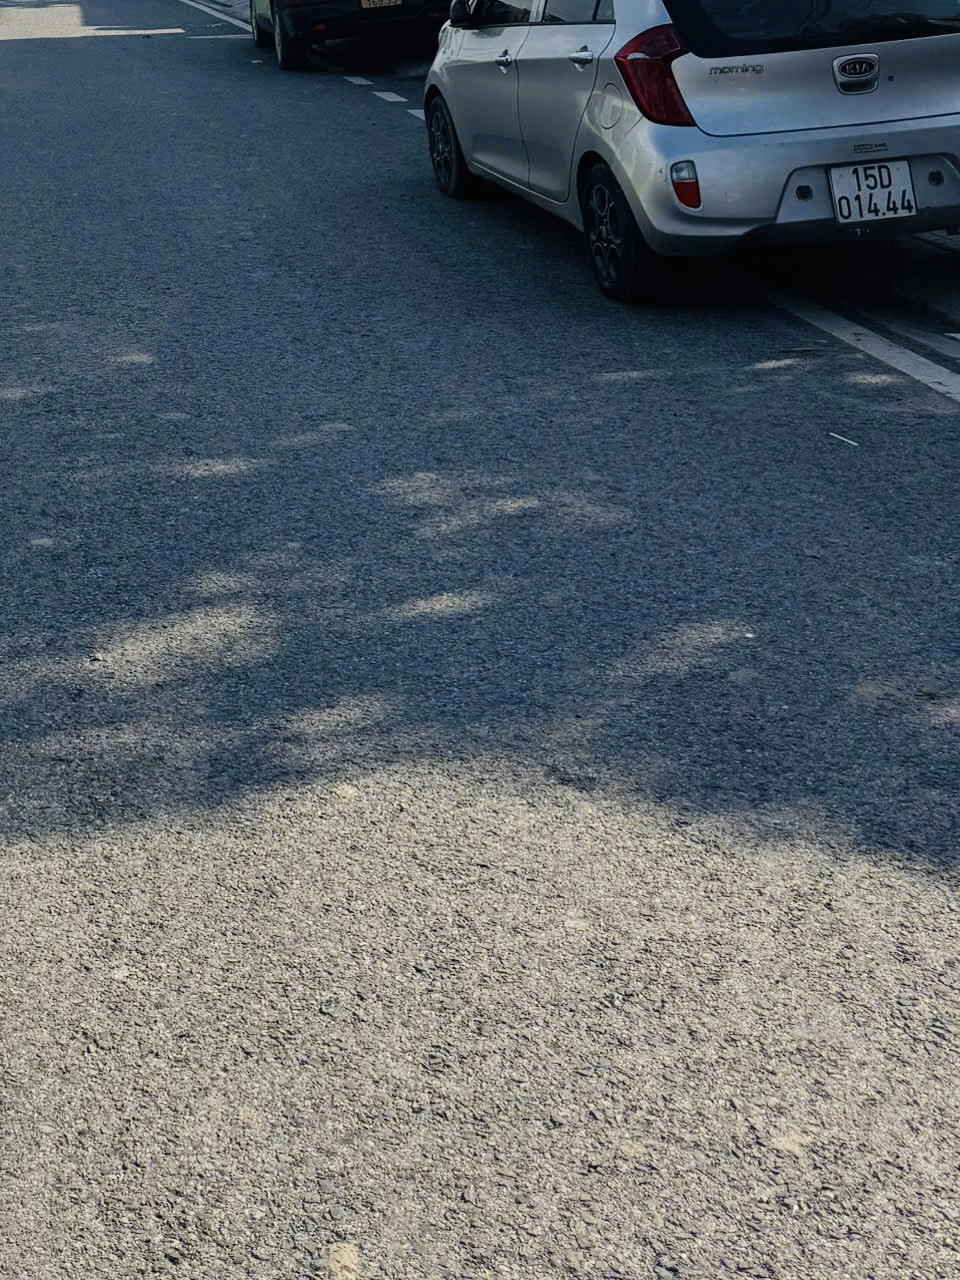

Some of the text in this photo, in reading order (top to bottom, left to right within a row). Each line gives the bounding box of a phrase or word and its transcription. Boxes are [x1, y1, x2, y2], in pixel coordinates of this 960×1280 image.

[708, 63, 764, 75] morning
[845, 62, 871, 75] KIA
[851, 164, 892, 192] 15D
[837, 189, 914, 220] 014.44
